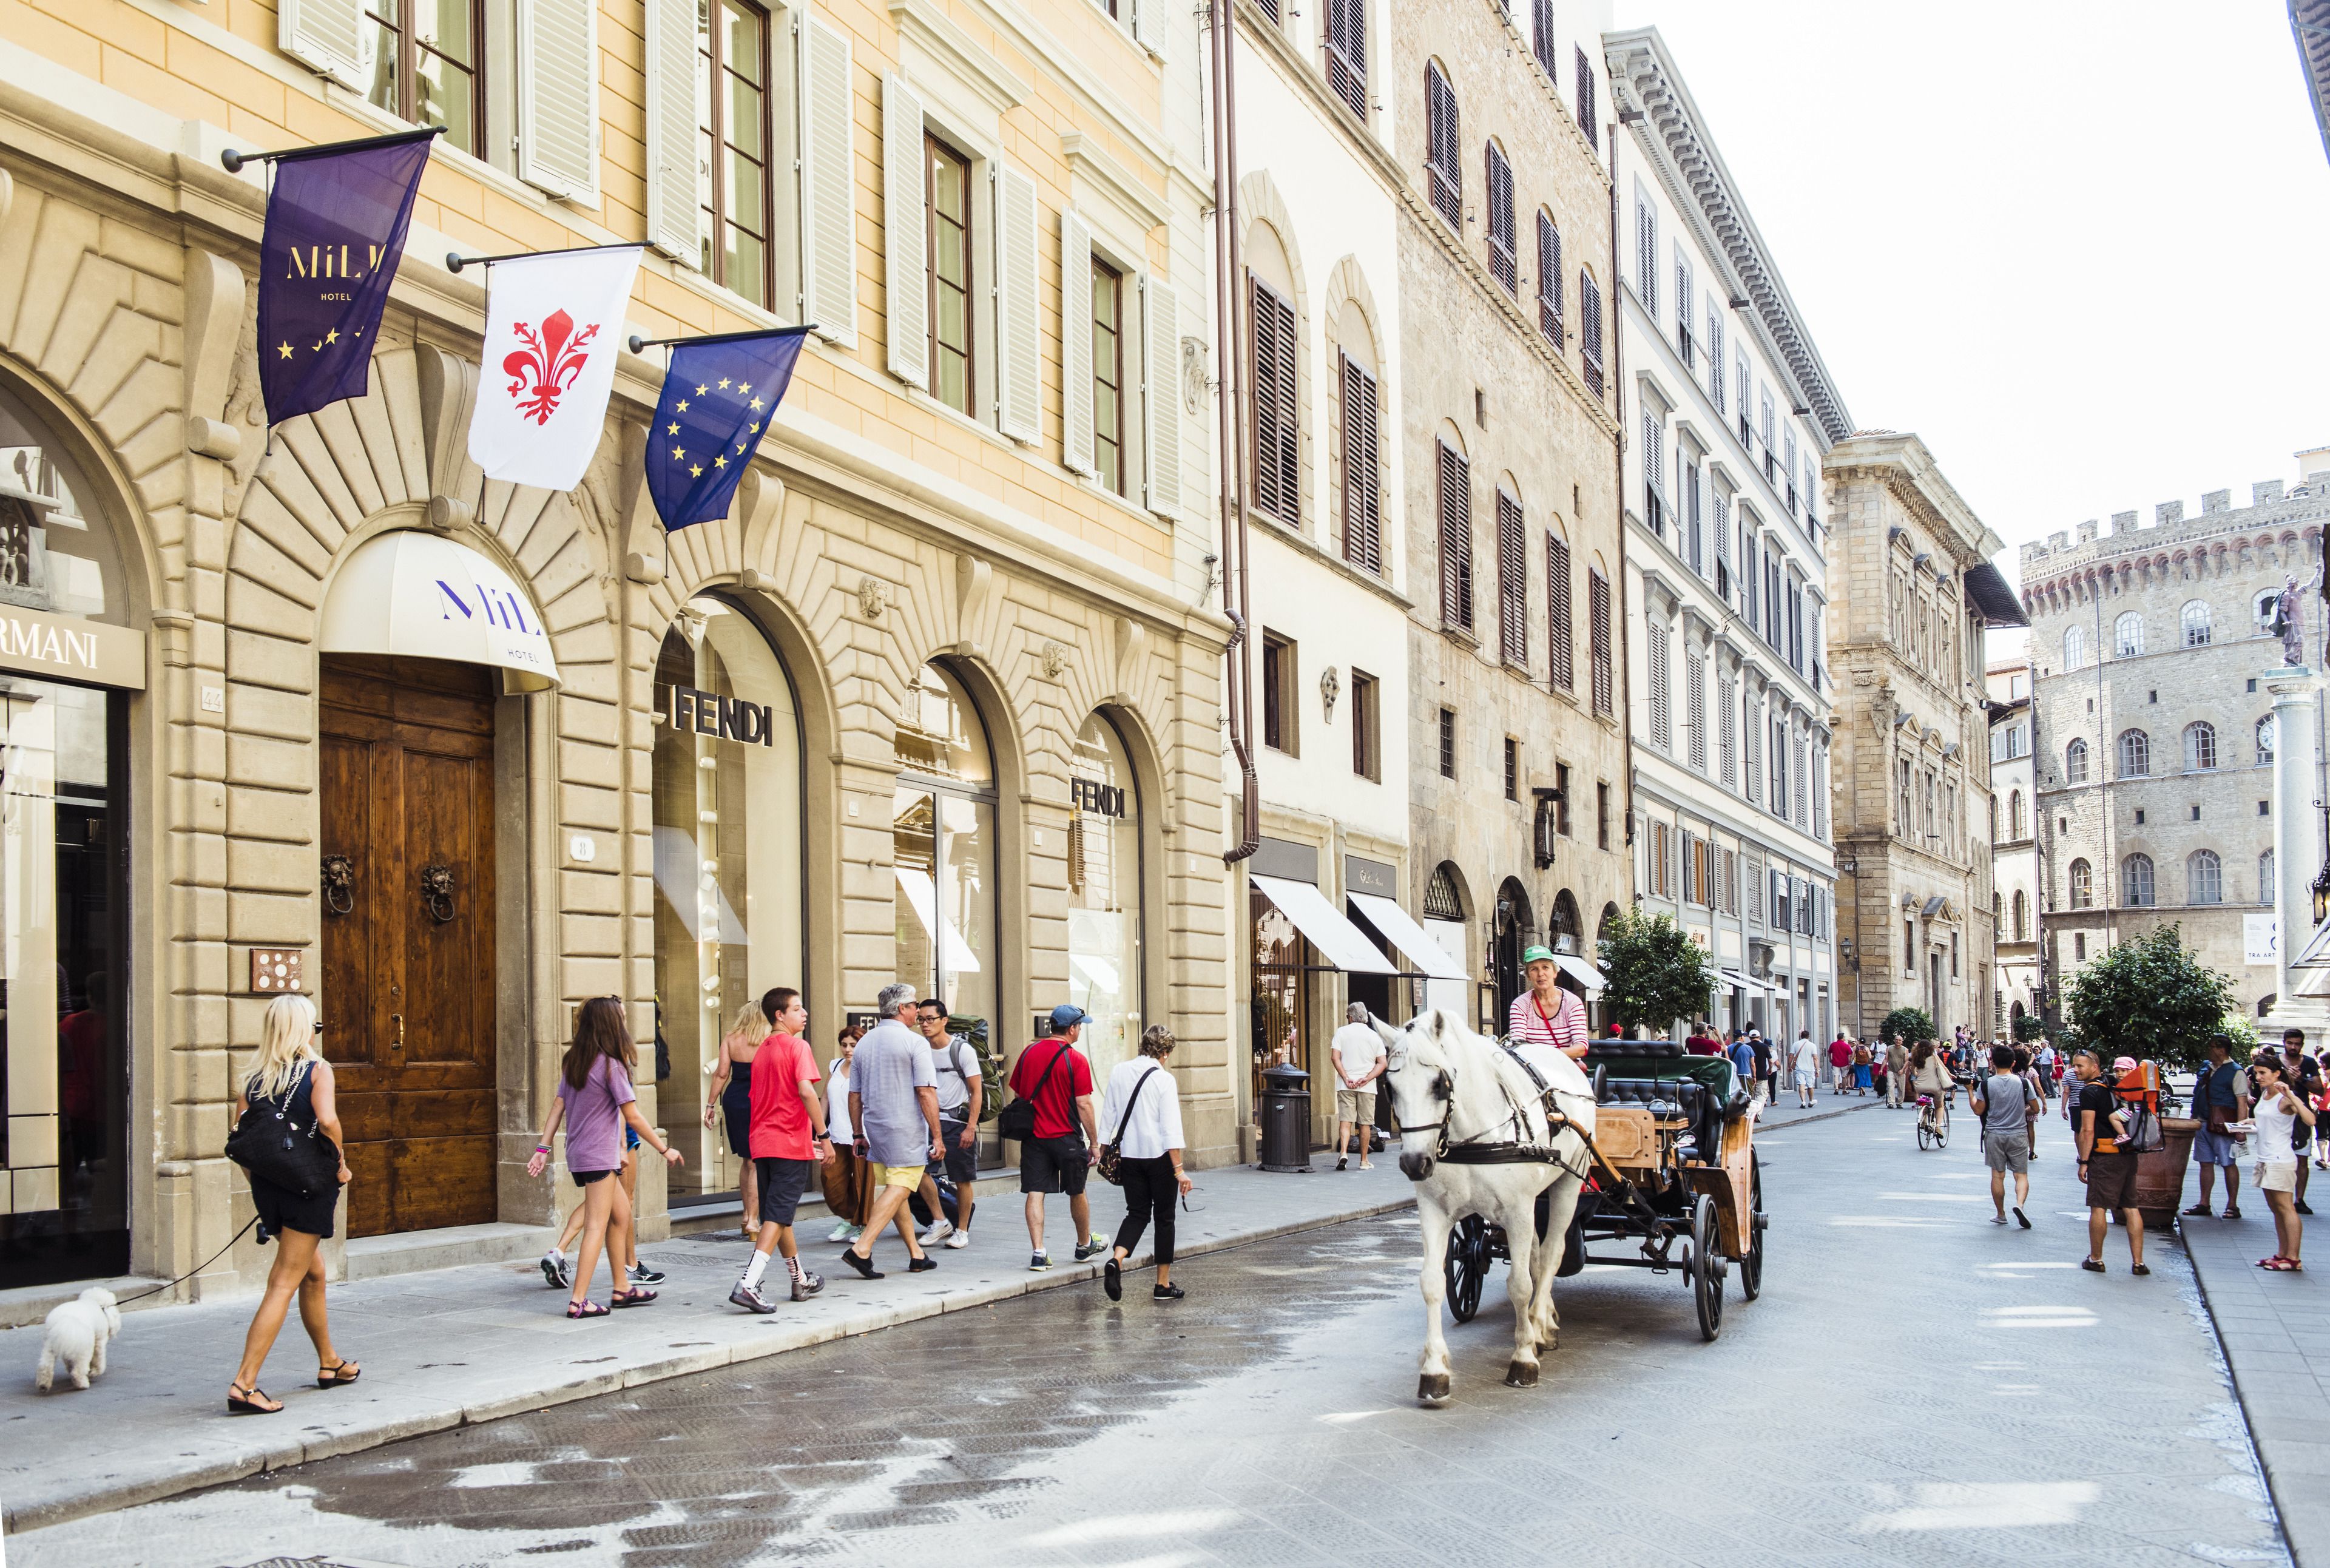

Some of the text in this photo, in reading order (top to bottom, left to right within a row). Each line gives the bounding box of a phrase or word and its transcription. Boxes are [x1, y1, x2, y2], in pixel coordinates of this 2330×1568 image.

[508, 649, 539, 663] HOTEL
[203, 692, 222, 709] 44
[673, 684, 772, 748] FENDI
[1070, 777, 1125, 819] FENDI
